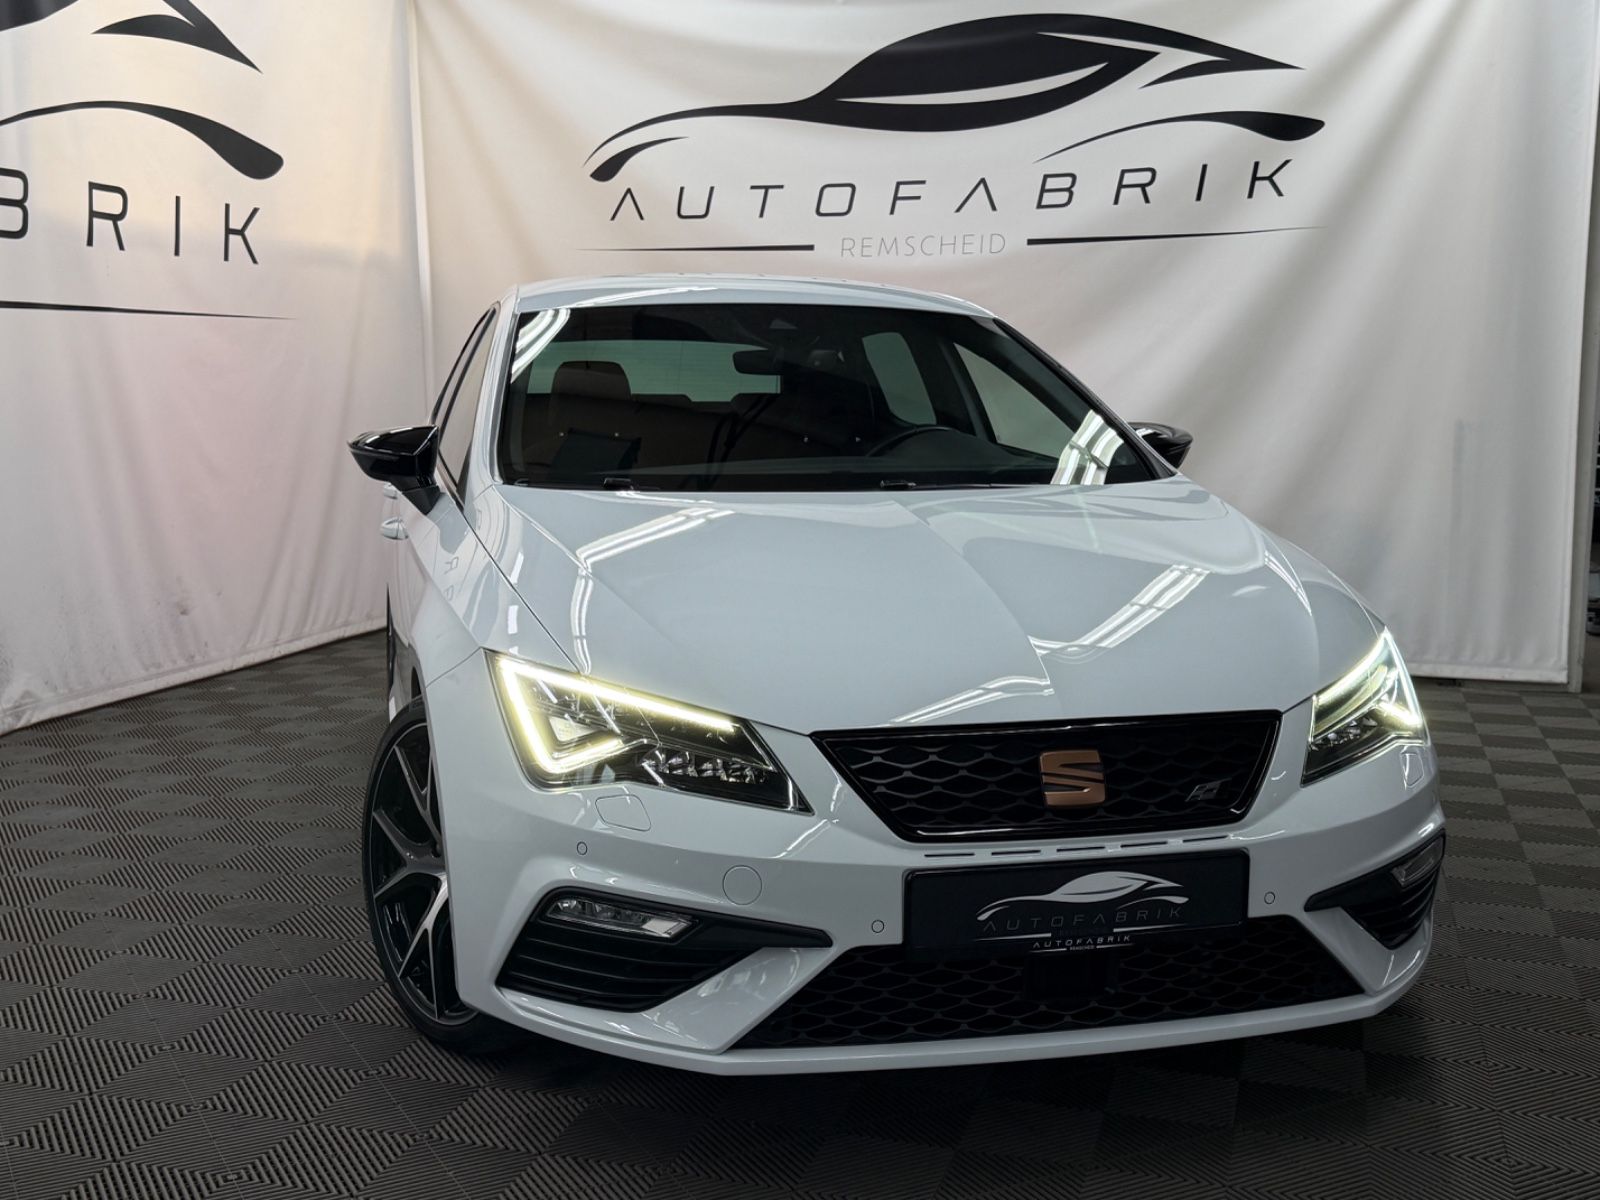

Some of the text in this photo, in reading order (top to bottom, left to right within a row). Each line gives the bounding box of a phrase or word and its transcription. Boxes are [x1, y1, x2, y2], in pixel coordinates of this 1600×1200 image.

[610, 159, 1293, 221] AUTOFABRIK
[840, 233, 1007, 259] REMSCHEID
[983, 906, 1184, 933] AUTOFABRIK
[1032, 935, 1131, 949] AUTOFABRIK
